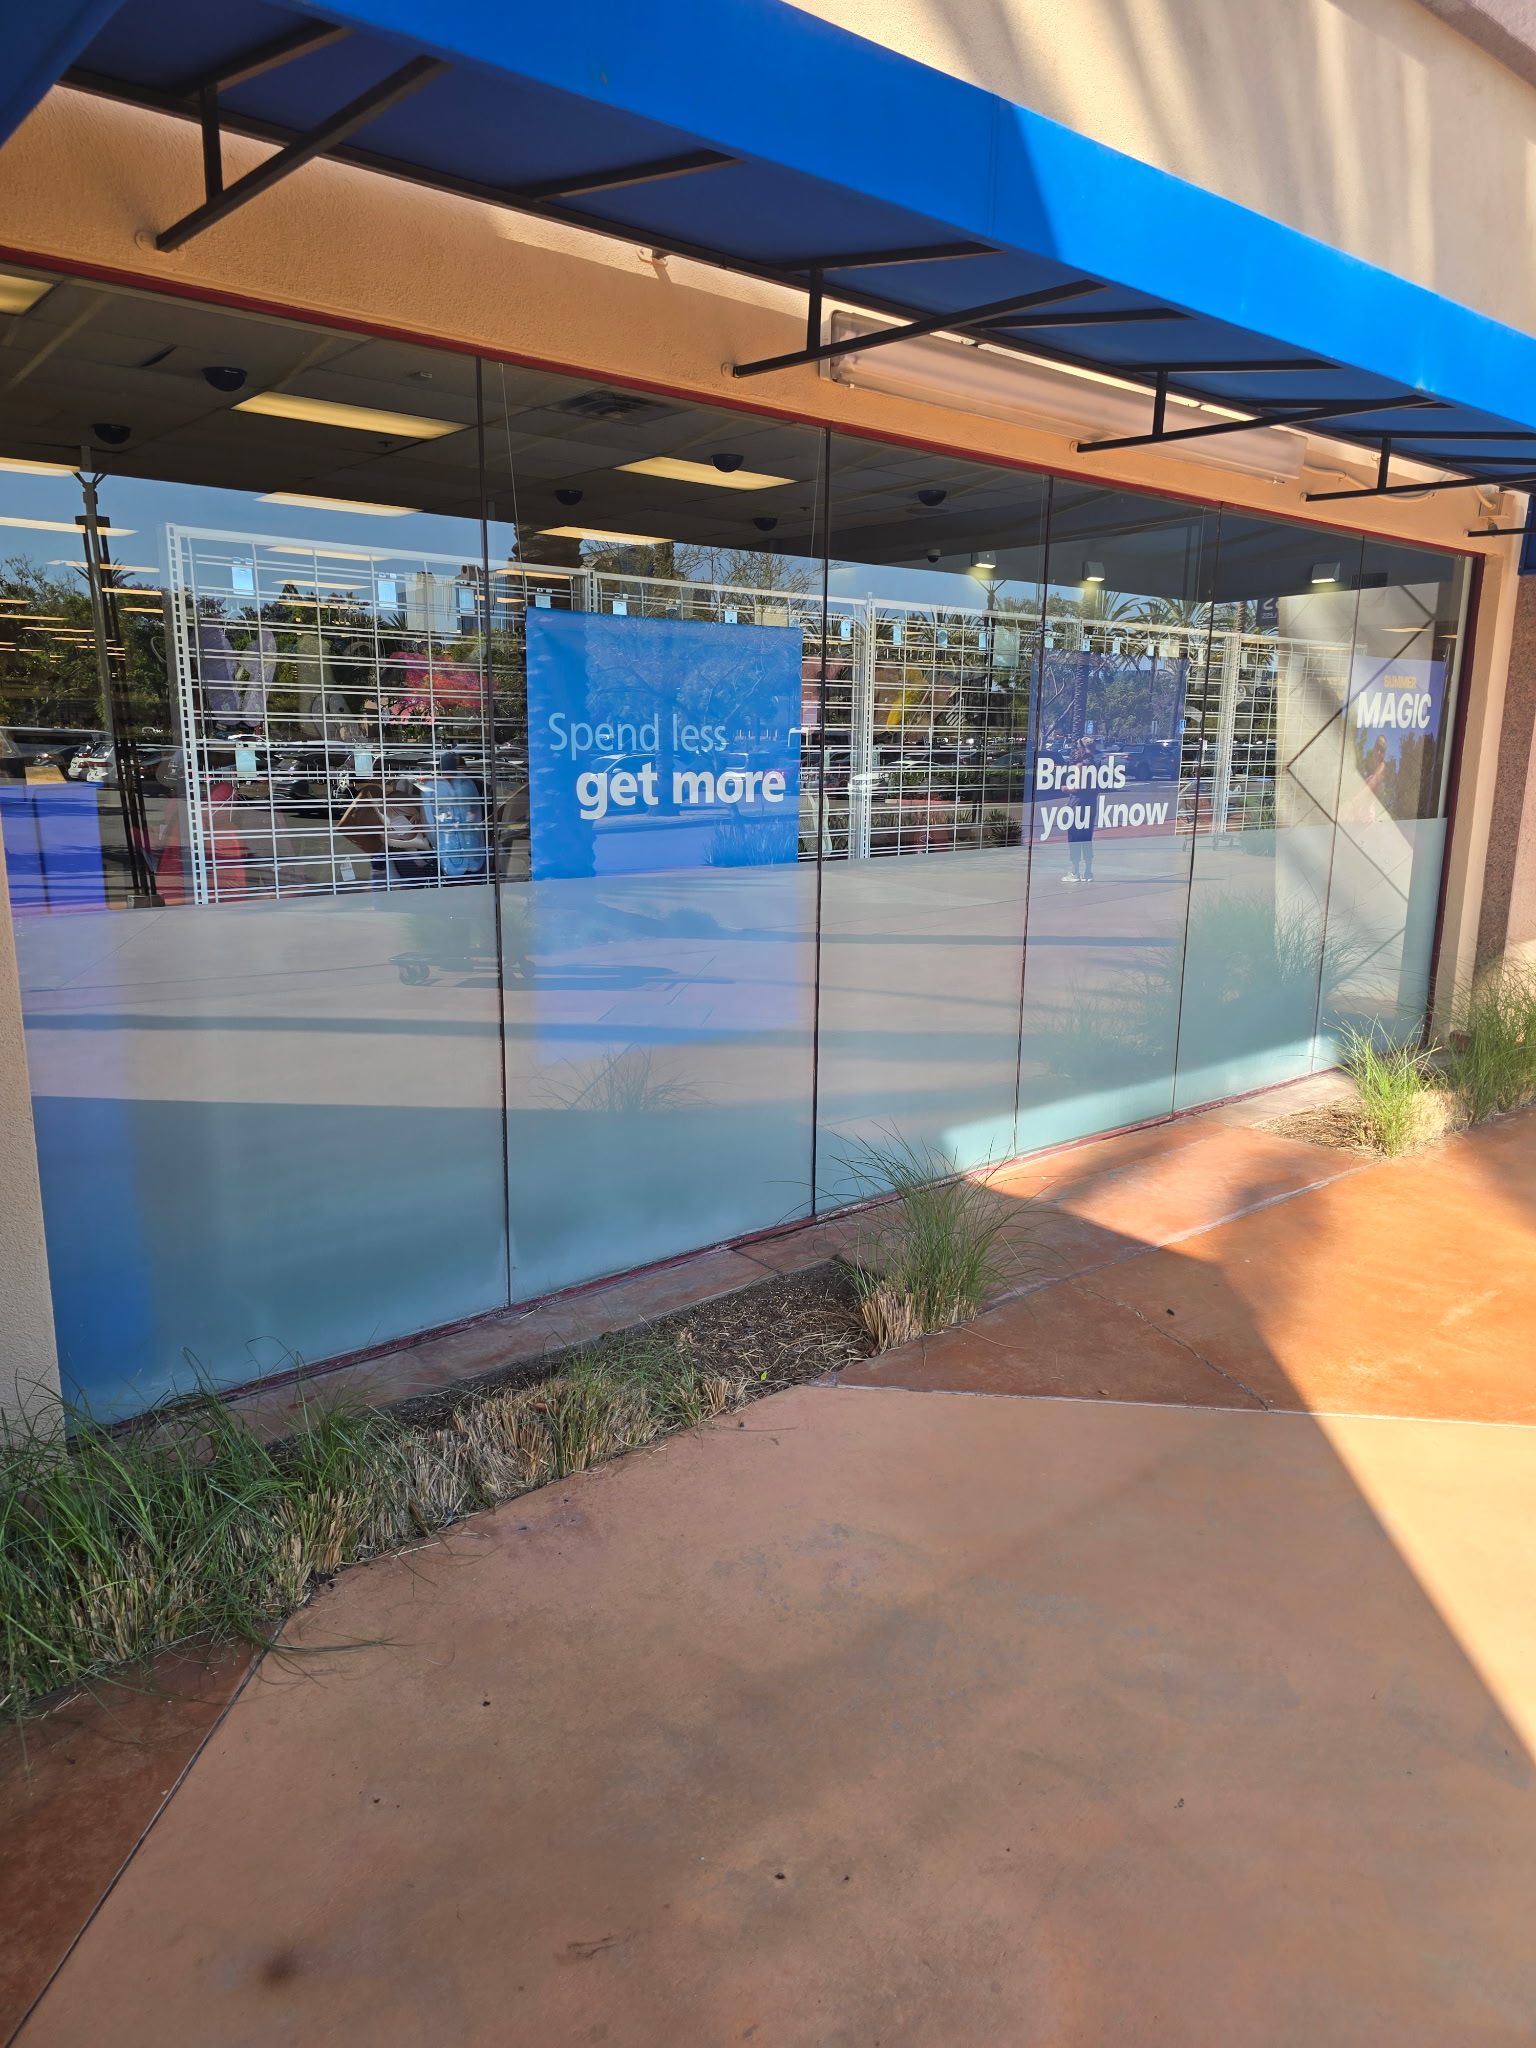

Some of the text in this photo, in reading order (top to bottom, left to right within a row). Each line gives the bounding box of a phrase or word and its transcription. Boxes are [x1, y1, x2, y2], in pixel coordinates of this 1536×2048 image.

[1384, 675, 1417, 689] SUMMER
[1357, 692, 1432, 729] MAGIC
[549, 713, 726, 760] Spend less
[576, 762, 786, 820] get more
[1036, 756, 1126, 790] Brands
[1040, 796, 1168, 841] you know
